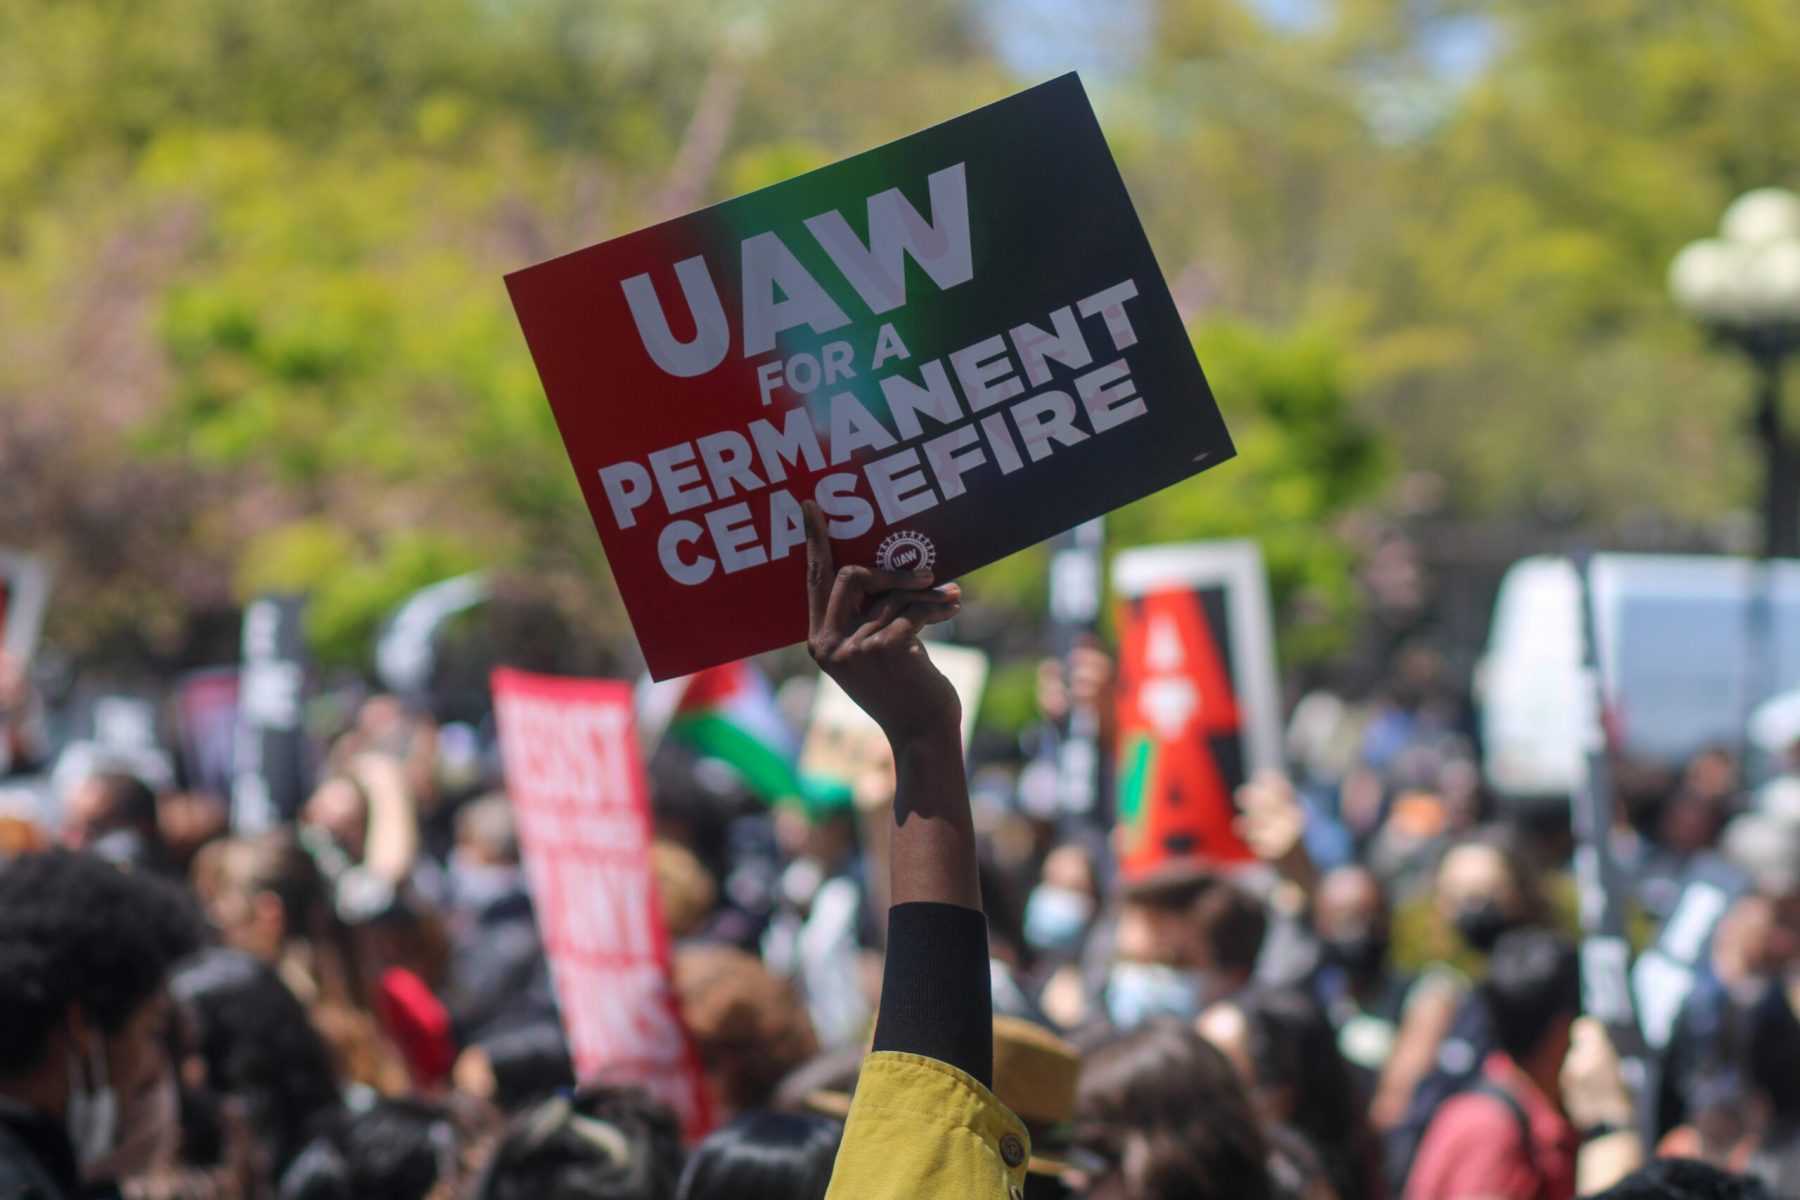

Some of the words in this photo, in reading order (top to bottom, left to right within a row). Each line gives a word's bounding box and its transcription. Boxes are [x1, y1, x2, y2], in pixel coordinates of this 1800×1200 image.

[621, 162, 973, 377] UAW
[757, 341, 855, 405] FOR
[872, 323, 911, 370] A
[598, 279, 1139, 529] PERMANENT
[657, 358, 1148, 586] CEASEFIRE
[892, 548, 918, 568] UAW
